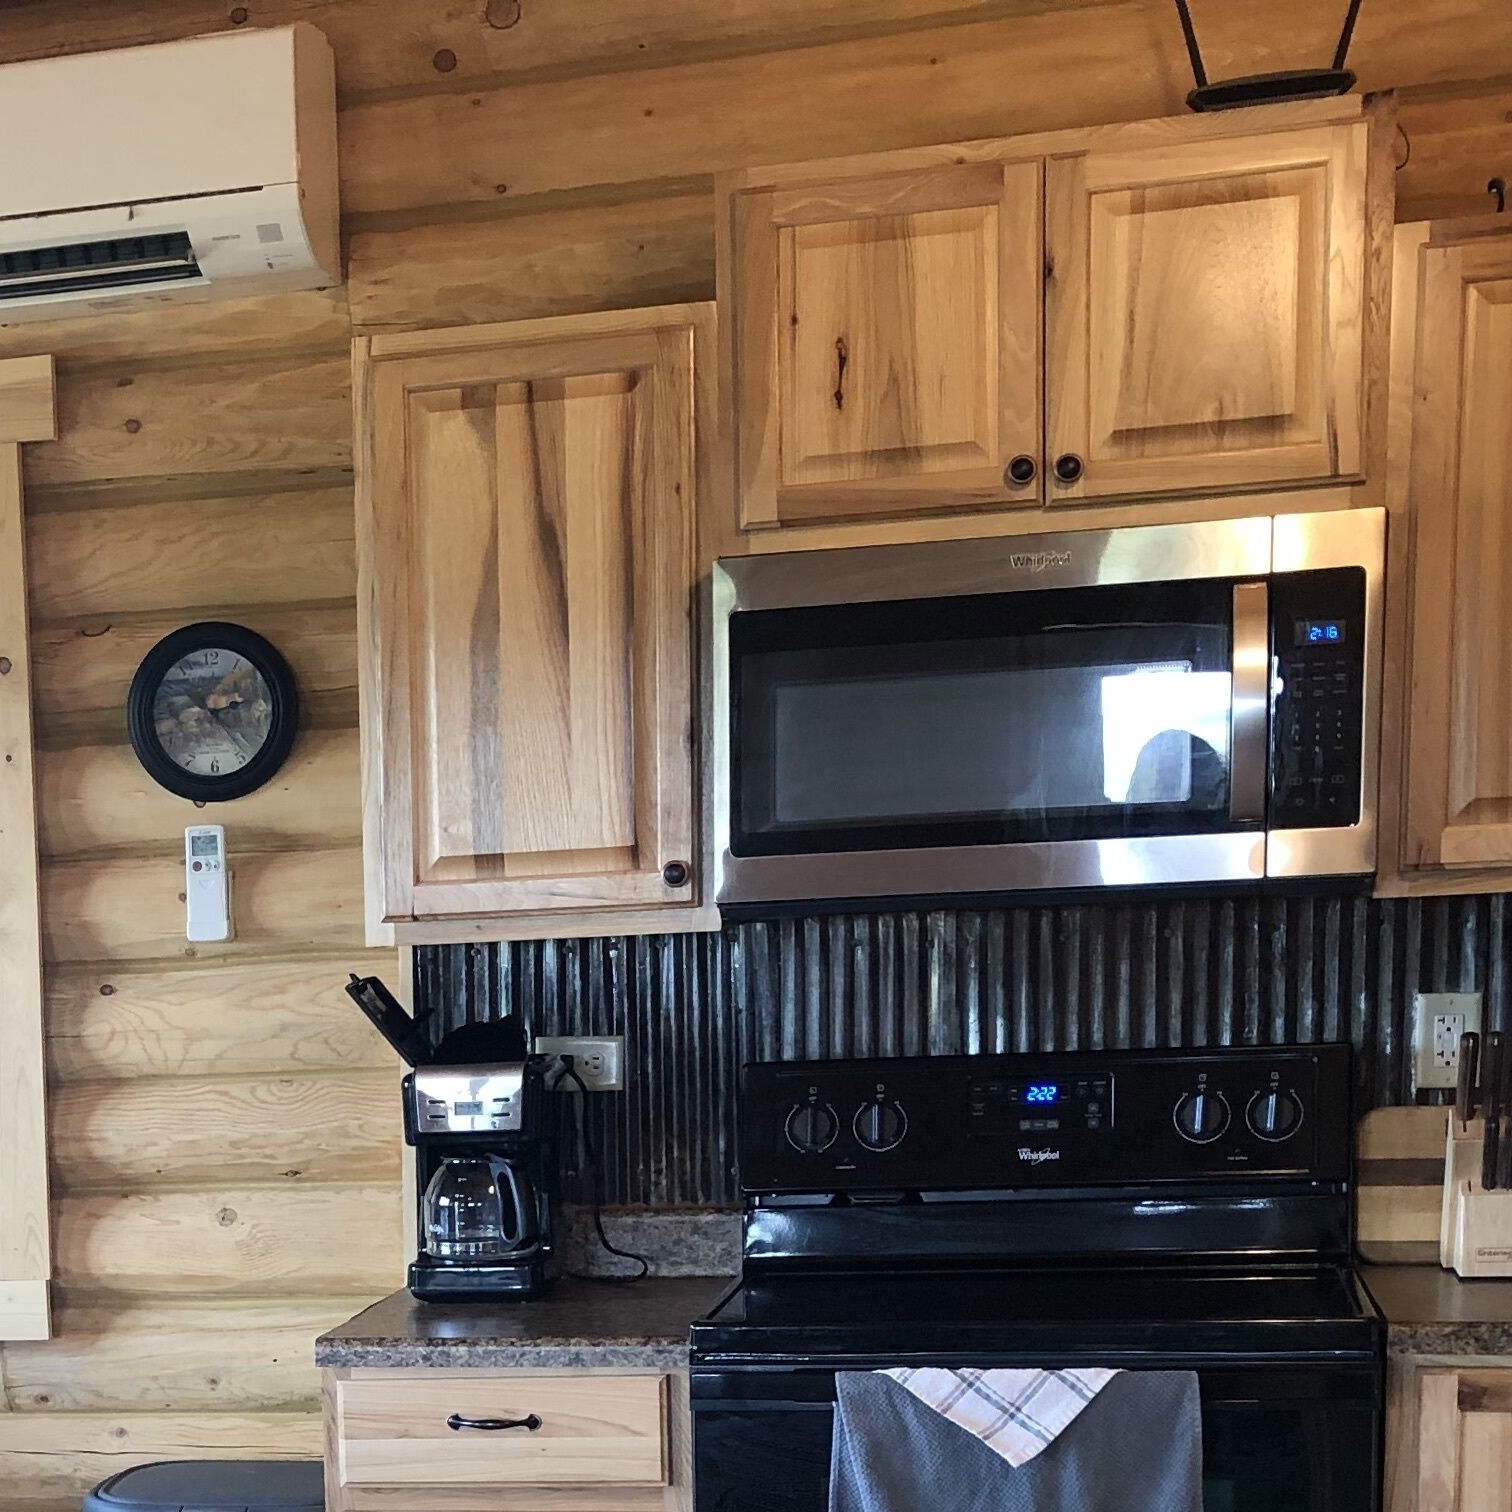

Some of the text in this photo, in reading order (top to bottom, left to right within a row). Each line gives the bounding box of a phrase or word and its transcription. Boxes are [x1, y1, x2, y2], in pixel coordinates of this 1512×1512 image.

[1010, 551, 1072, 571] Whirlpool
[204, 651, 219, 665] 12
[210, 759, 220, 773] 6
[1018, 1148, 1060, 1163] Whirlpool
